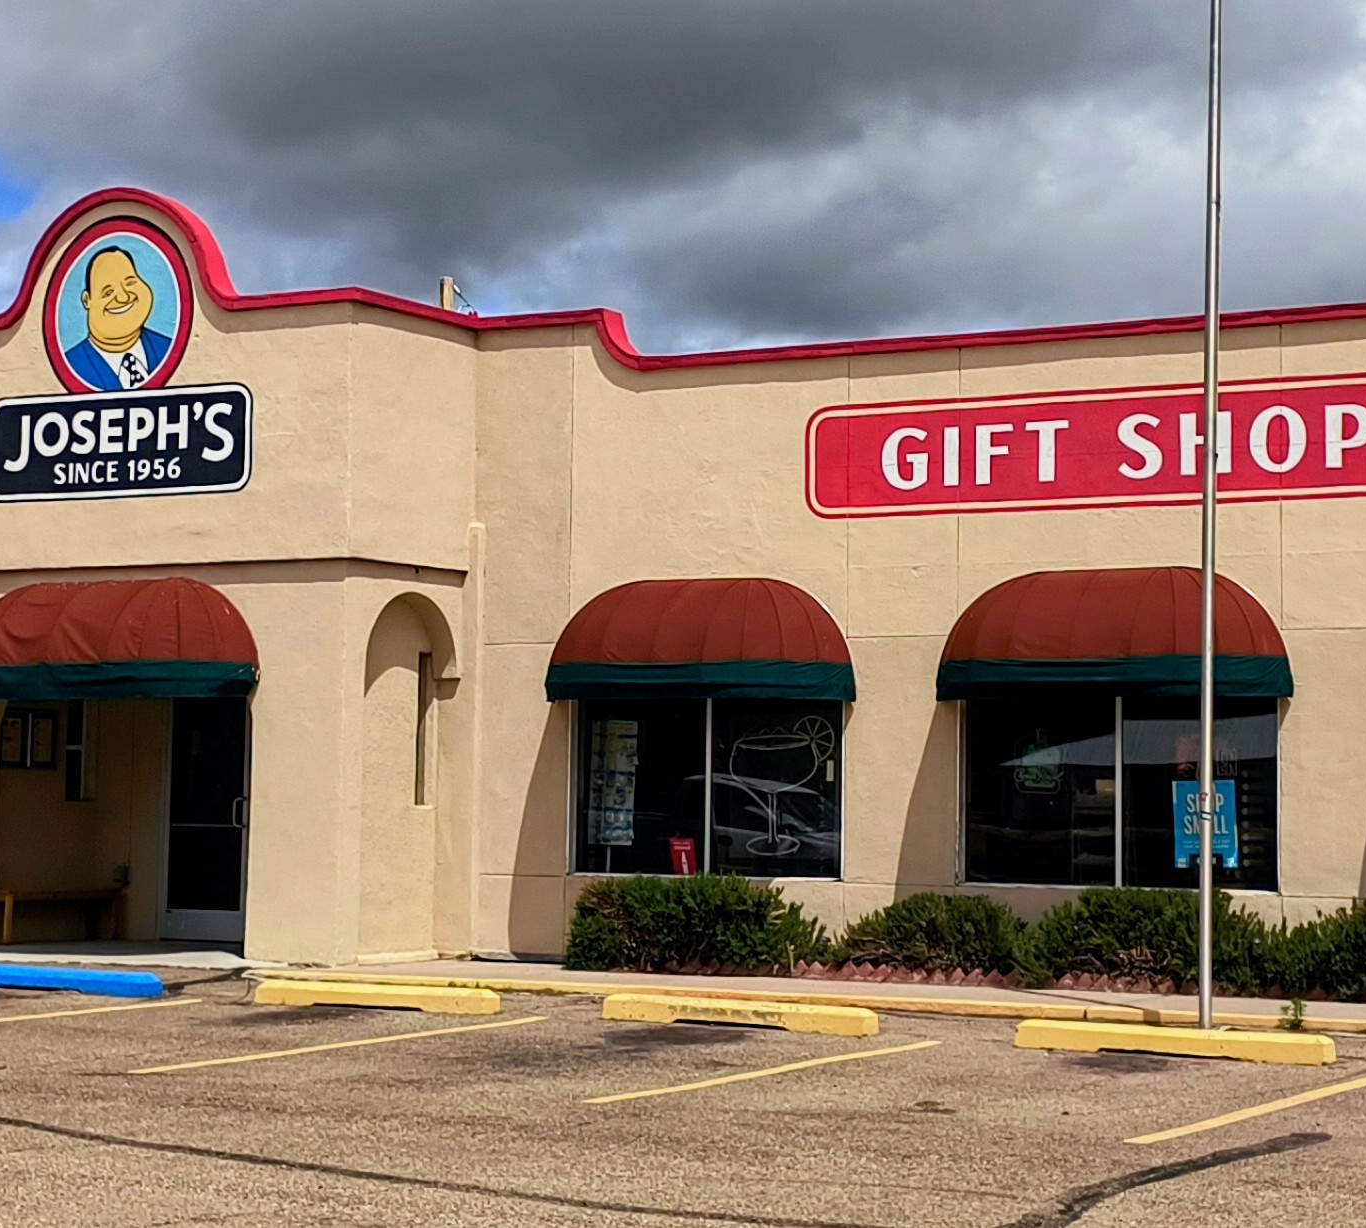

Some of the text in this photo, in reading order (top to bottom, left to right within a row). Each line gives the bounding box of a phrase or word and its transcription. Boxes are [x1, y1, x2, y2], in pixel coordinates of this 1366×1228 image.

[3, 401, 234, 472] JOSEPH'S
[881, 419, 1069, 490] GIFT
[53, 457, 181, 485] SINCE 1956
[1186, 793, 1225, 813] SP
[1183, 815, 1230, 835] SLL
